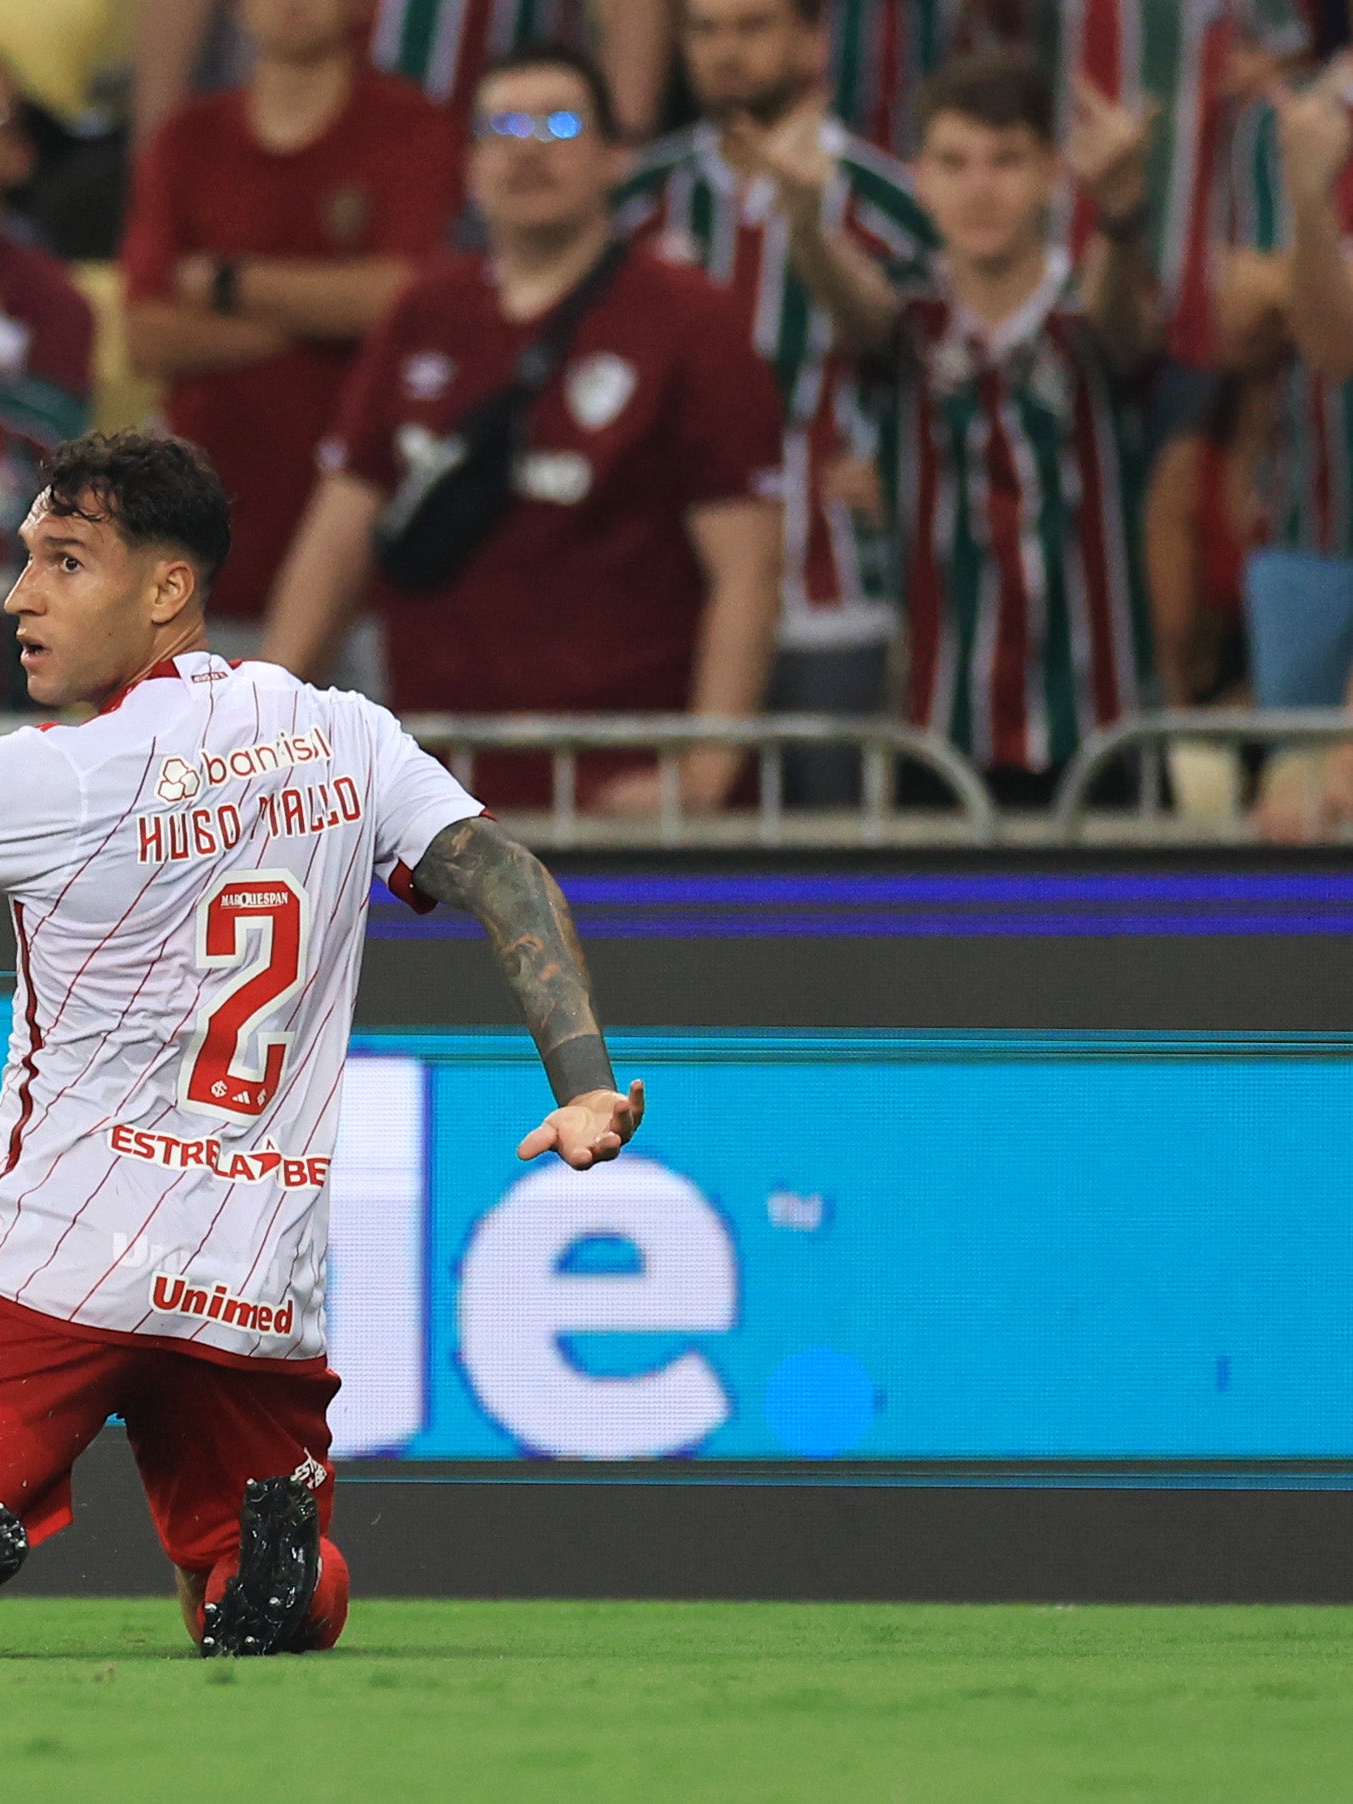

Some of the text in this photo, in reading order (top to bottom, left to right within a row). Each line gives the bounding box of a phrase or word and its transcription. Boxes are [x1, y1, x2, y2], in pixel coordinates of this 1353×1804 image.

[139, 805, 241, 862] HUGO
[182, 876, 305, 1120] 2
[284, 1158, 331, 1187] BE
[153, 1276, 294, 1334] Unimed
